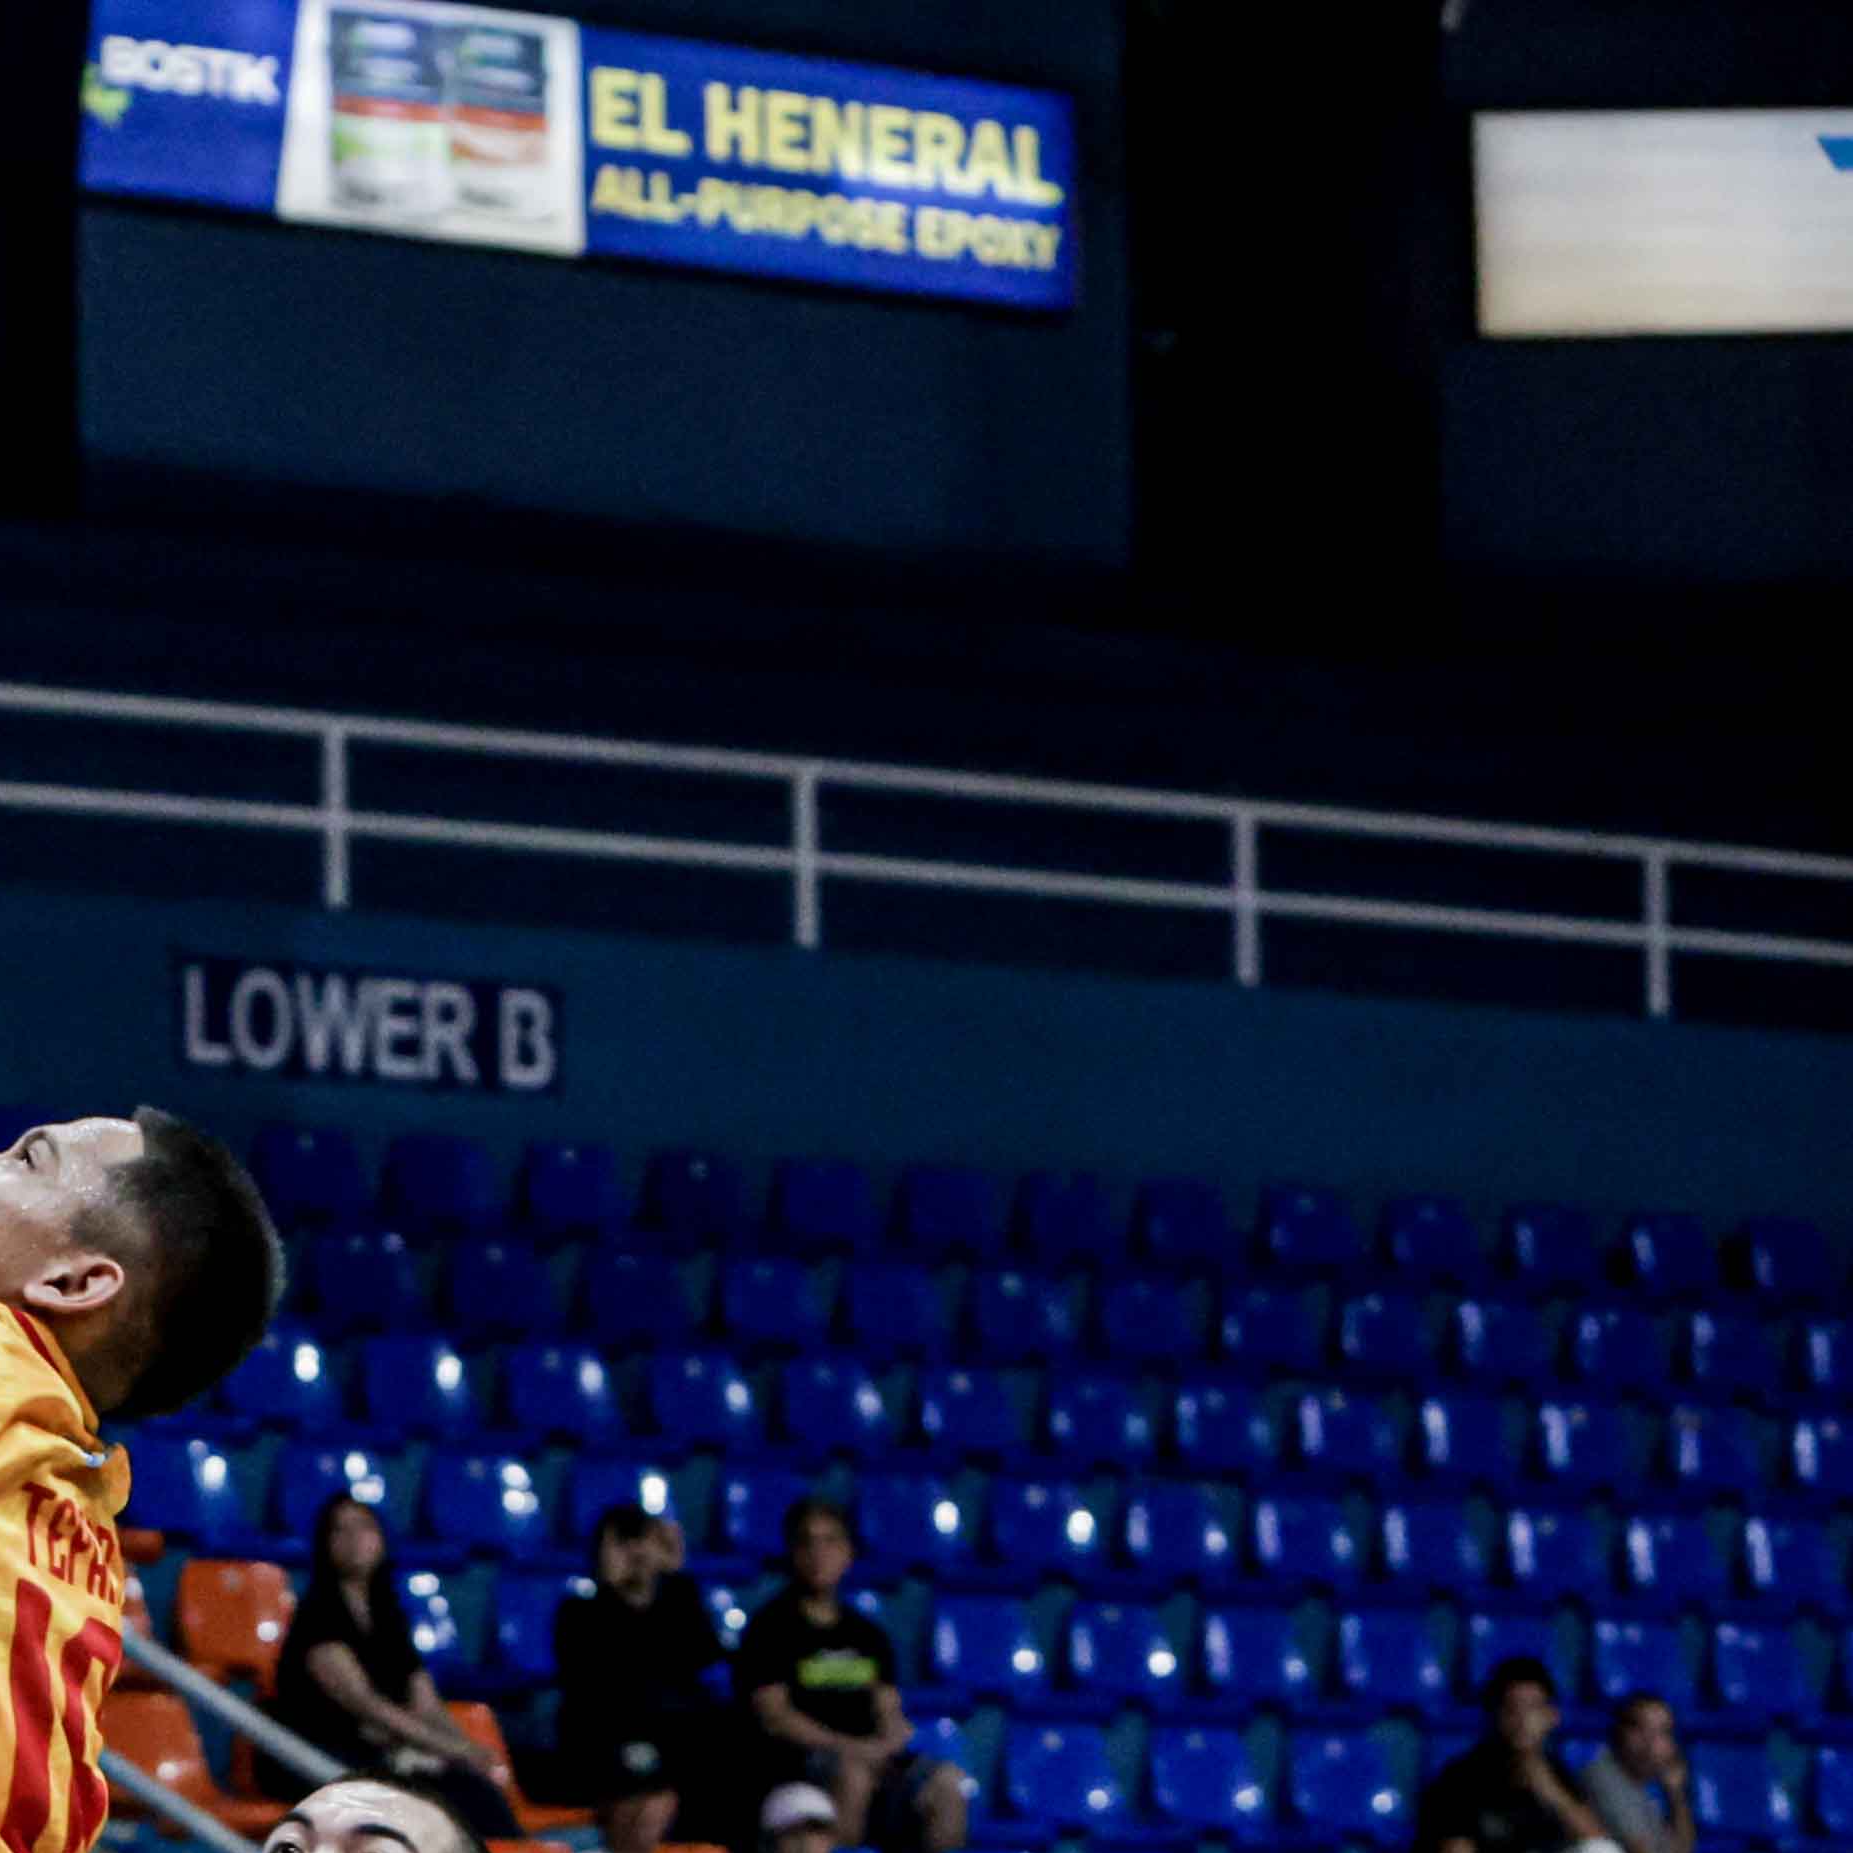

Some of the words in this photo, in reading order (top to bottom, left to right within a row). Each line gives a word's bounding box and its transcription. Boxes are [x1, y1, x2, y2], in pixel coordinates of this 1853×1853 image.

[589, 68, 692, 155] EL
[704, 82, 1064, 206] HENERAL
[591, 164, 909, 254] ALL-PURPOSE
[916, 206, 1063, 271] EPOXY
[184, 964, 479, 1082] LOWER
[498, 988, 556, 1091] B
